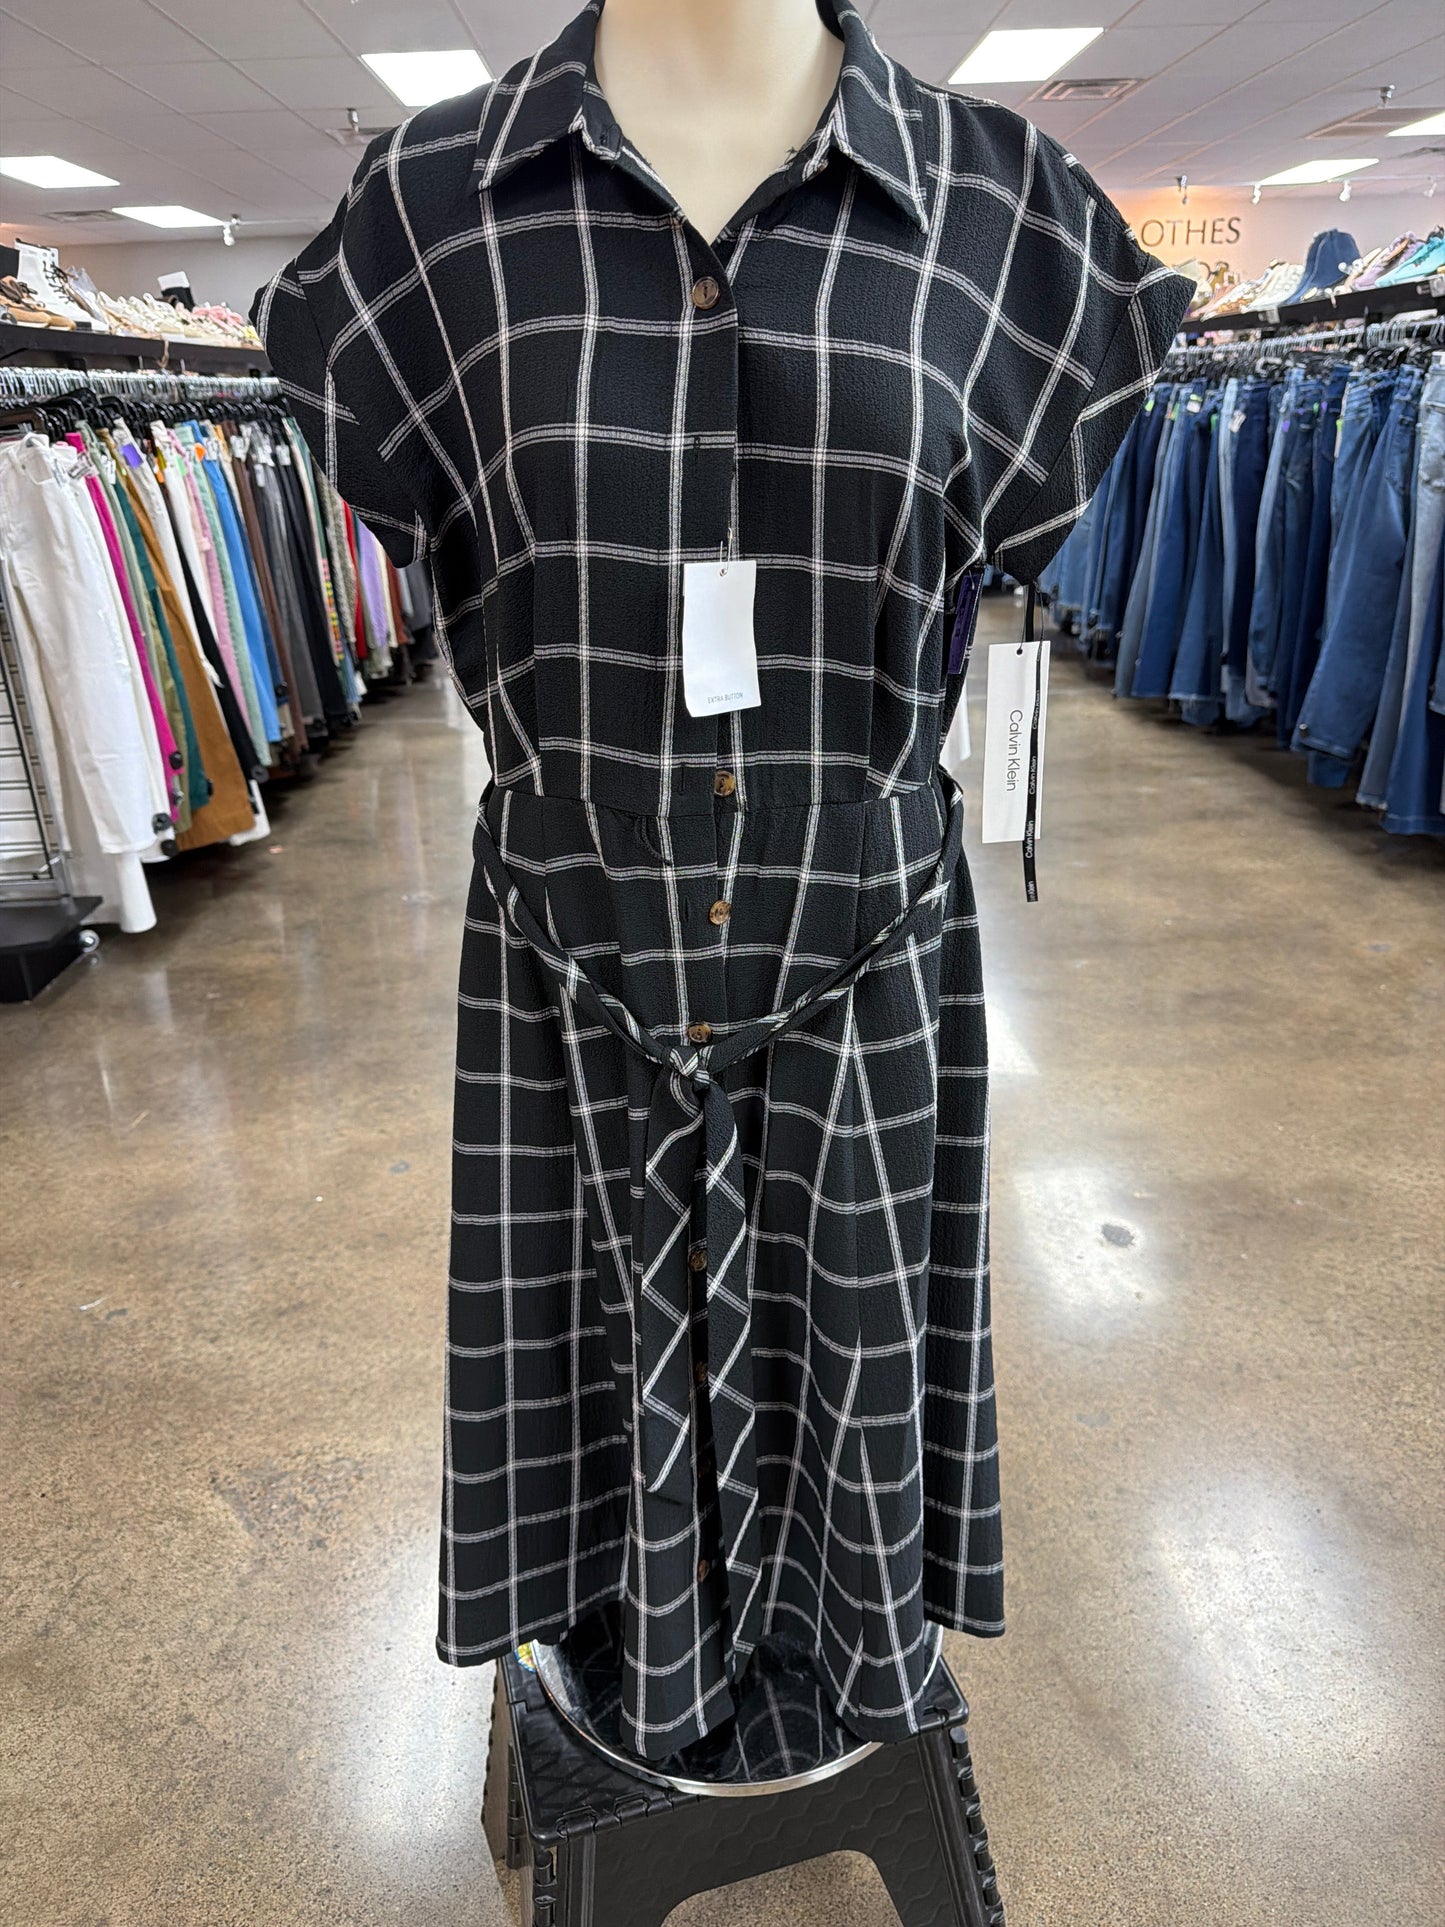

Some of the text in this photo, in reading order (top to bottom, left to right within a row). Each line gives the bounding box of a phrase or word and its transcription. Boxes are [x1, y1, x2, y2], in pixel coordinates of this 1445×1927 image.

[1006, 709, 1023, 792] Calvin Klein
[1025, 820, 1034, 859] Calvin Klein
